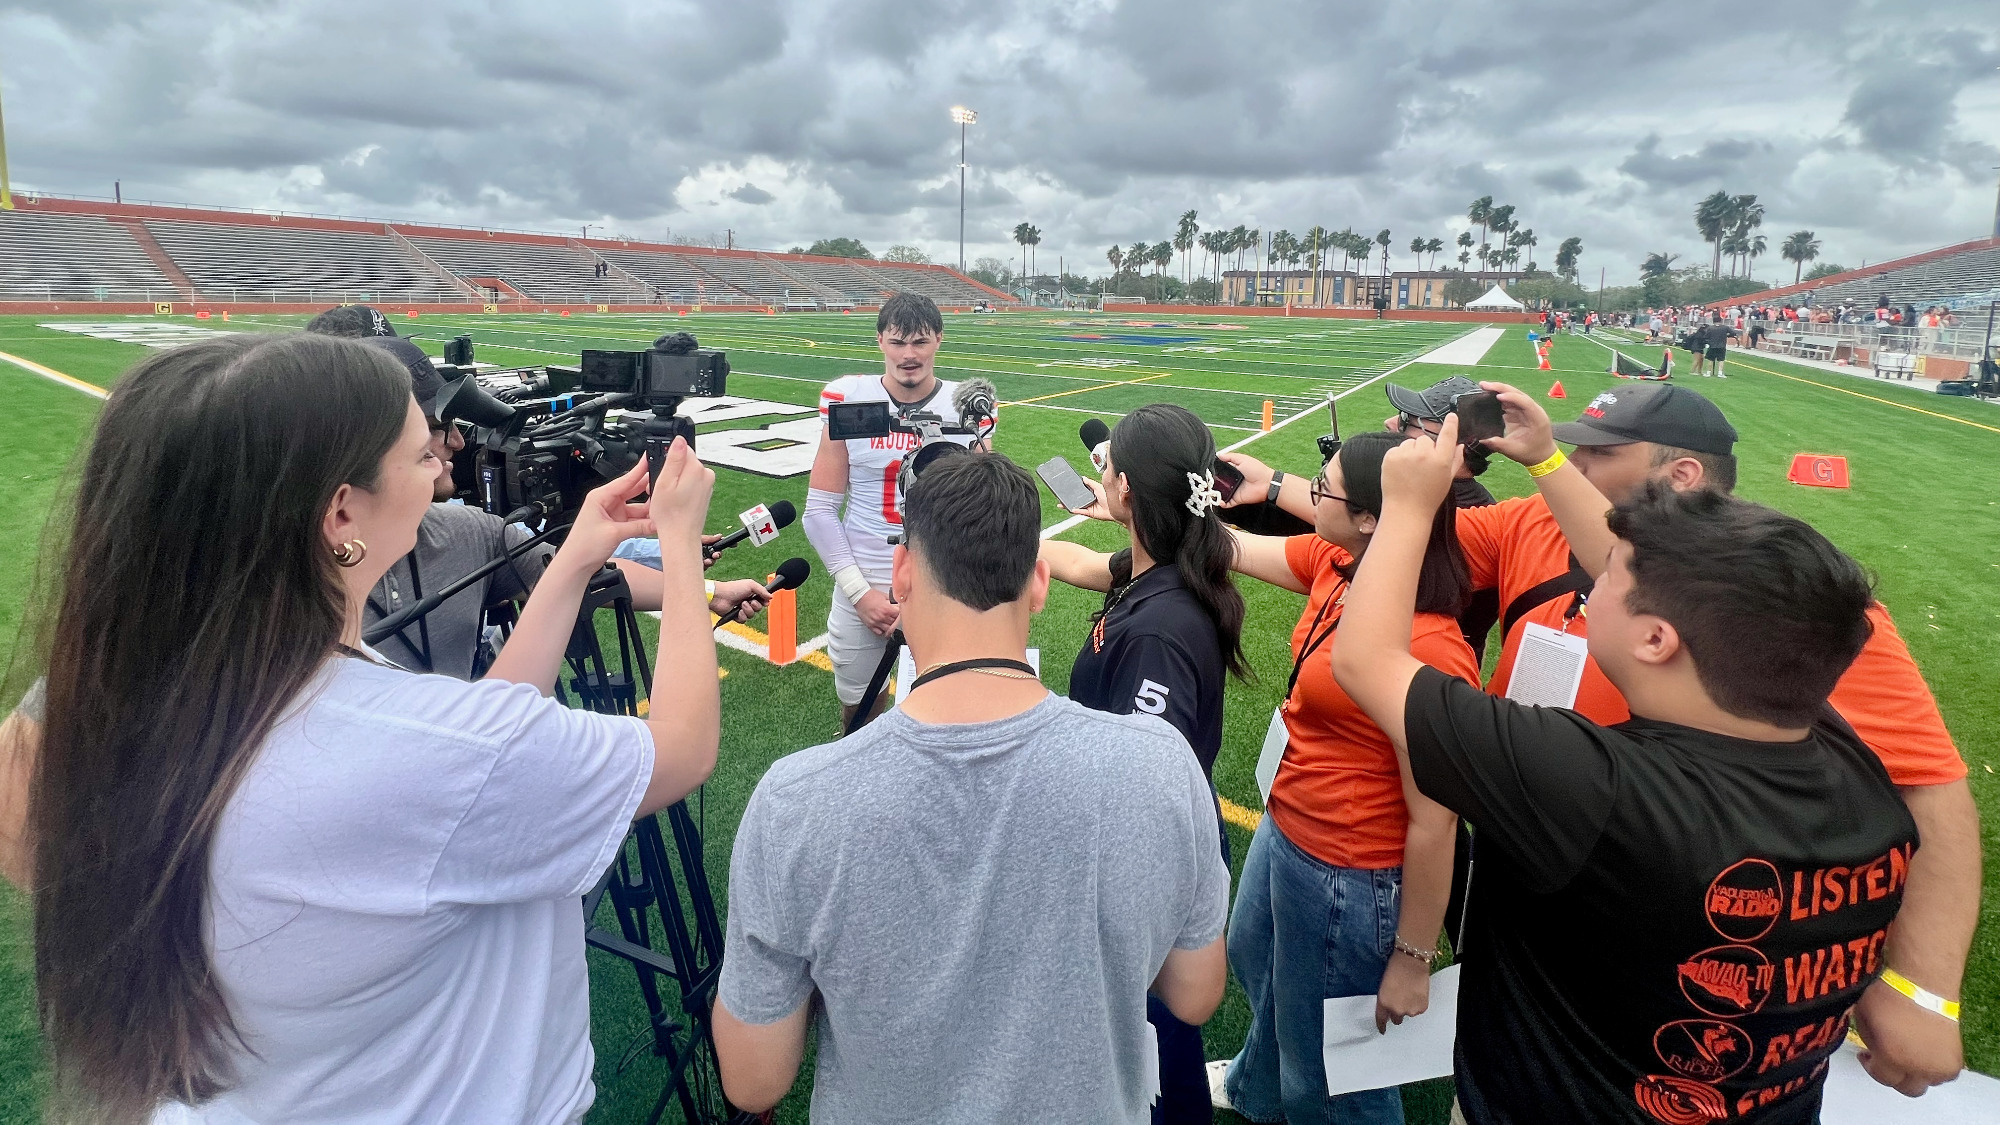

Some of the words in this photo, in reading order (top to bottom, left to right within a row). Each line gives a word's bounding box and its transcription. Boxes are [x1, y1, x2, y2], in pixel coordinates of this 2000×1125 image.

[1812, 458, 1833, 482] G
[1134, 678, 1170, 715] 5
[1790, 842, 1911, 921] LISTEN
[1709, 894, 1782, 917] RADIO
[1784, 929, 1888, 1004] WATC
[1667, 1054, 1727, 1077] RIDER
